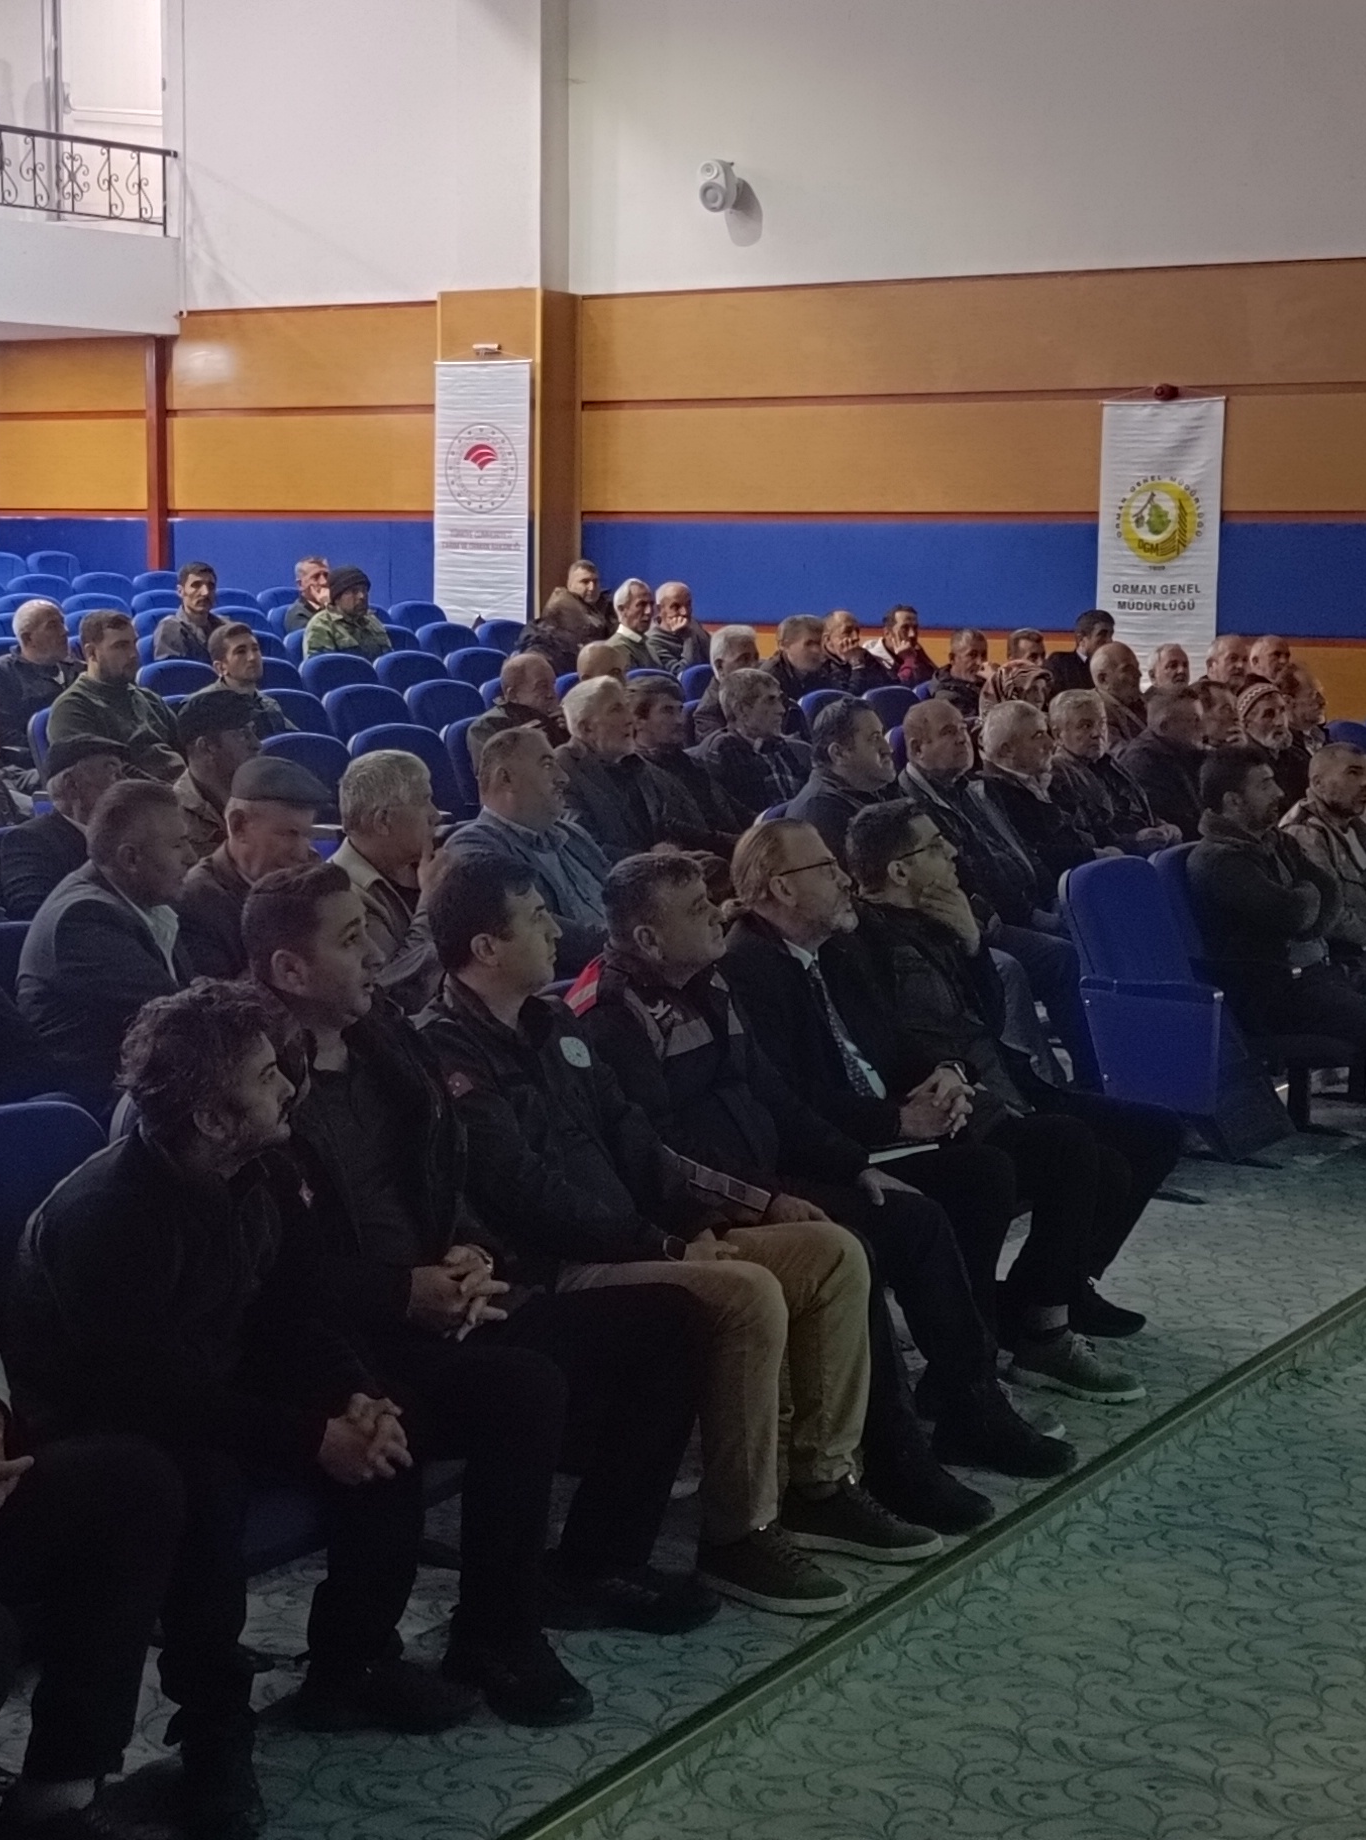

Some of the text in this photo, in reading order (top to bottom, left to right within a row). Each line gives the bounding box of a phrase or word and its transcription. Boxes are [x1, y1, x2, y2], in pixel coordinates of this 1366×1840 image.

[1112, 583, 1201, 594] ORMAN GENEL
[1117, 598, 1195, 611] MÜDÜRLÜĞÜ
